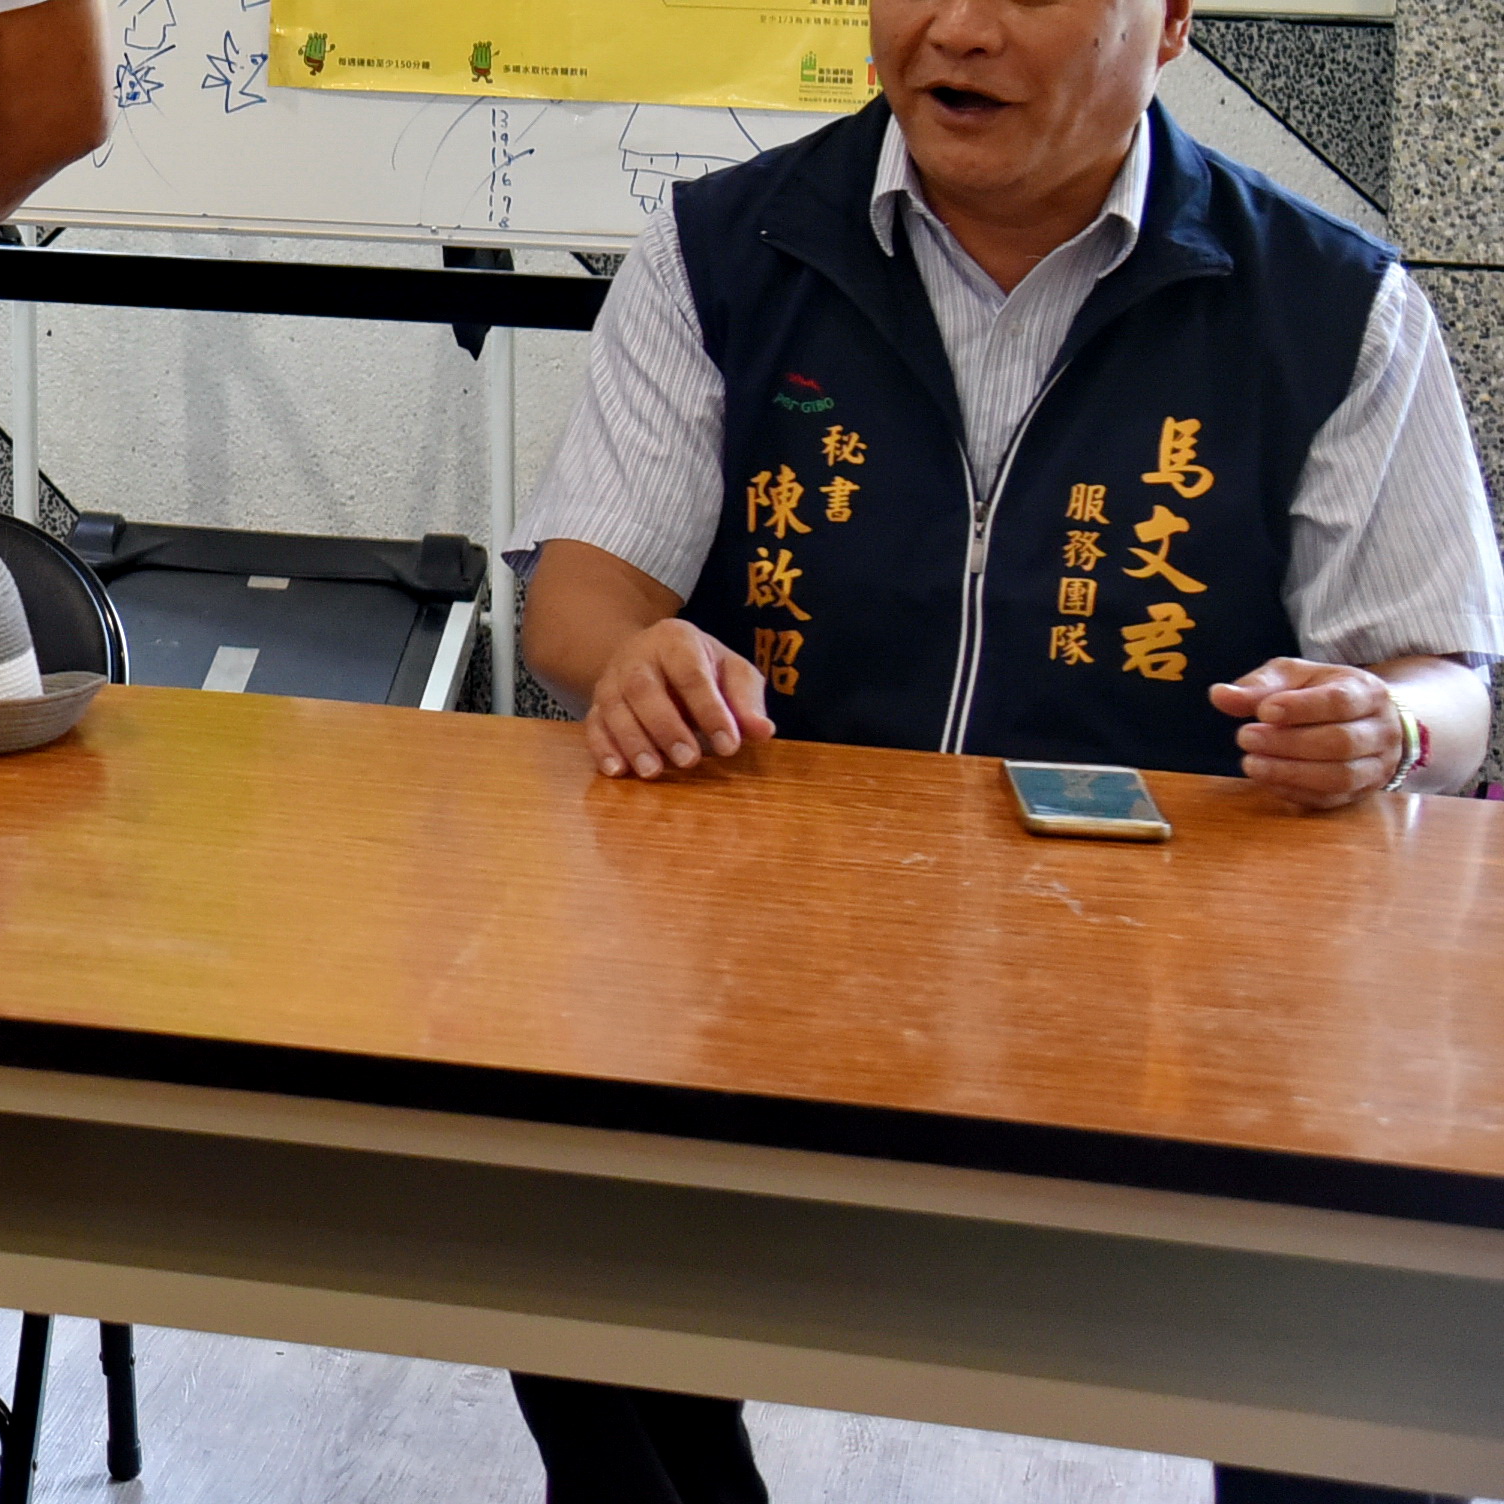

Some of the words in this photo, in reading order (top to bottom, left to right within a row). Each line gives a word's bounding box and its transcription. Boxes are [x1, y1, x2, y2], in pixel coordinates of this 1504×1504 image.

[818, 423, 868, 524] 秘書
[1048, 482, 1110, 666] 服務團隊
[1121, 415, 1216, 682] 馬文君
[744, 463, 813, 696] 陳啟昭
